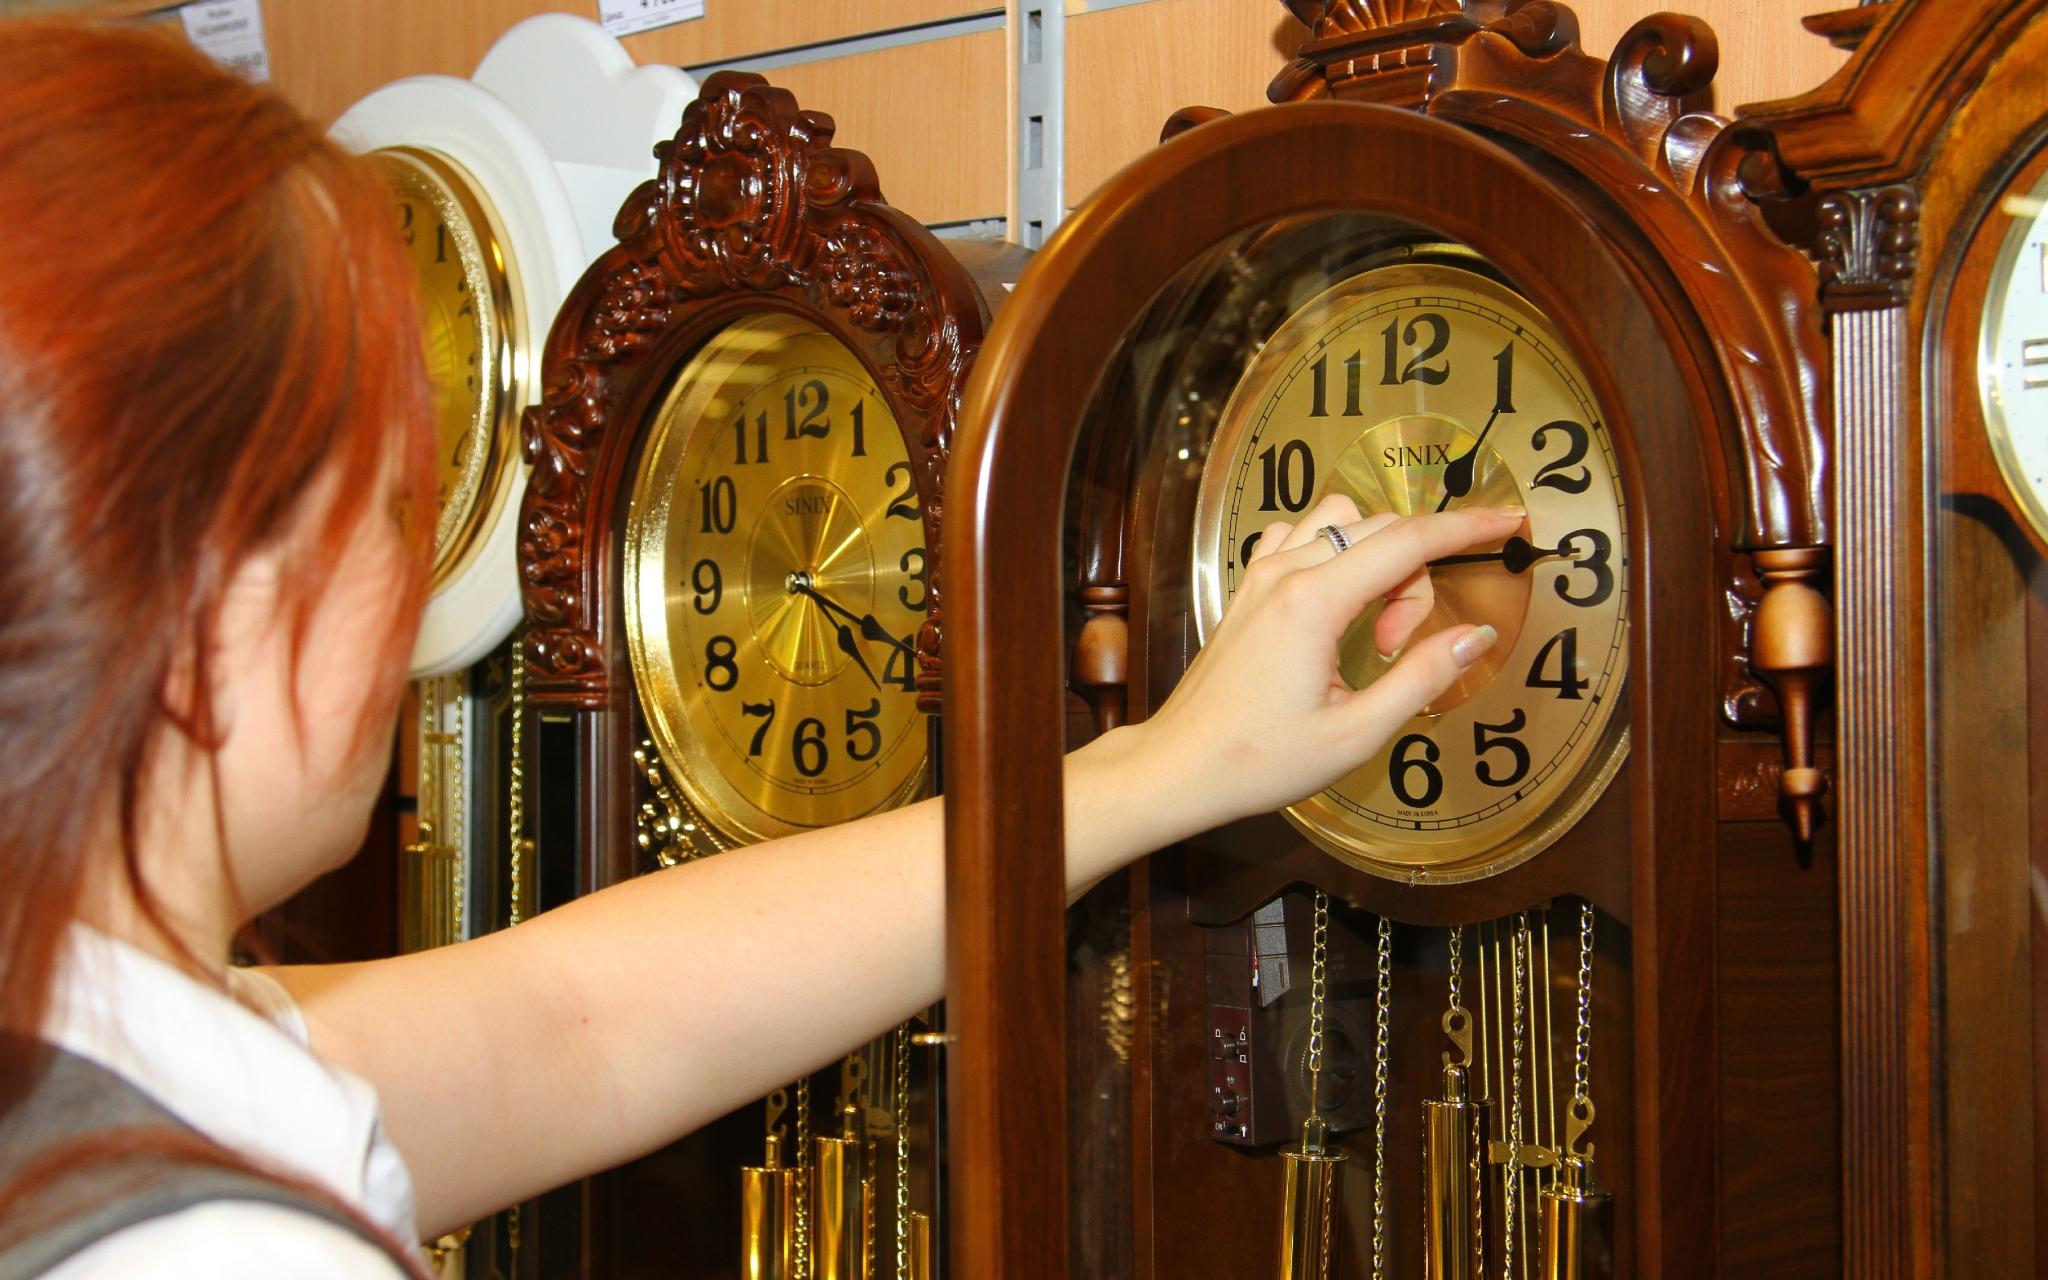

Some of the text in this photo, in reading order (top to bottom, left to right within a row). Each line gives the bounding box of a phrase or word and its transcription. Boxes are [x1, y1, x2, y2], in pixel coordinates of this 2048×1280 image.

[434, 224, 447, 263] 1
[1379, 313, 1450, 385] 12
[1493, 340, 1517, 413] 1
[783, 379, 831, 440] 12
[1309, 349, 1364, 417] 11
[734, 409, 770, 465] 11
[850, 398, 867, 457] 1
[1383, 443, 1451, 468] SINIX
[1531, 420, 1592, 494] 2
[699, 475, 737, 534] 10
[885, 461, 922, 521] 2
[1258, 439, 1315, 512] 10
[785, 496, 831, 516] SINIX
[692, 559, 722, 615] 9
[899, 547, 928, 612] 3
[1554, 528, 1615, 608] 3
[705, 635, 739, 692] 8
[882, 634, 917, 692] 4
[1525, 627, 1589, 700] 4
[742, 698, 775, 757] 7
[792, 718, 828, 778] 6
[846, 698, 882, 761] 5
[1474, 707, 1531, 787] 5
[1389, 733, 1443, 808] 6
